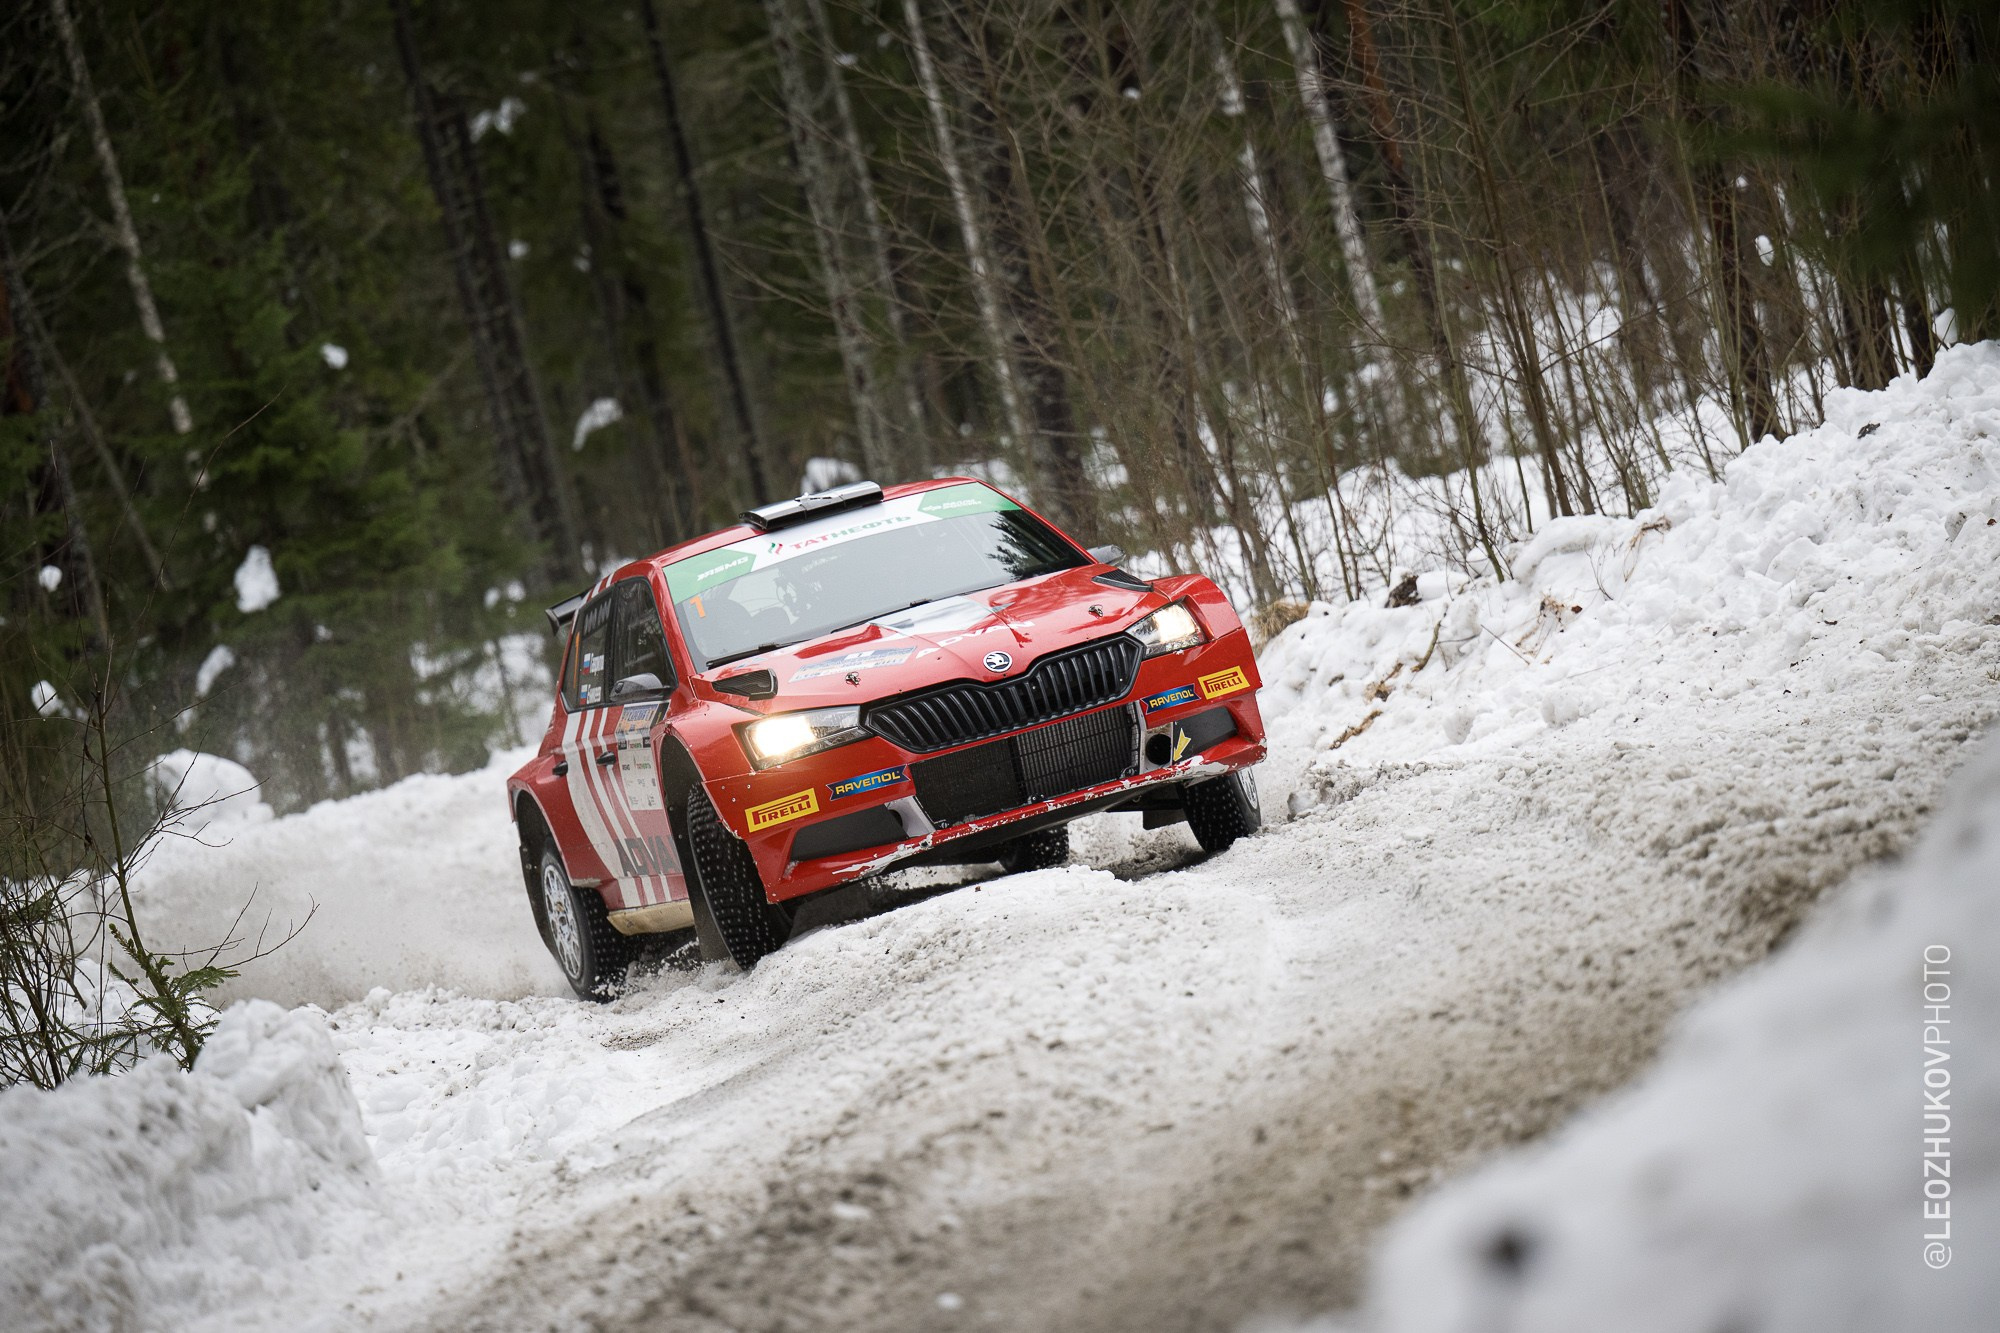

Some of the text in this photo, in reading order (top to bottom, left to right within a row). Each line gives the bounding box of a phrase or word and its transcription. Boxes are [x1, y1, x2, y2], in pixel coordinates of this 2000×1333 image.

[790, 516, 911, 549] ТАТНЕФТЬ
[689, 595, 706, 618] 1
[916, 621, 1035, 659] ADVAN
[1203, 671, 1243, 694] PIRELLI
[1149, 689, 1195, 708] RAVENOL
[835, 771, 901, 795] RAVENOL
[751, 794, 812, 826] PIRELLI
